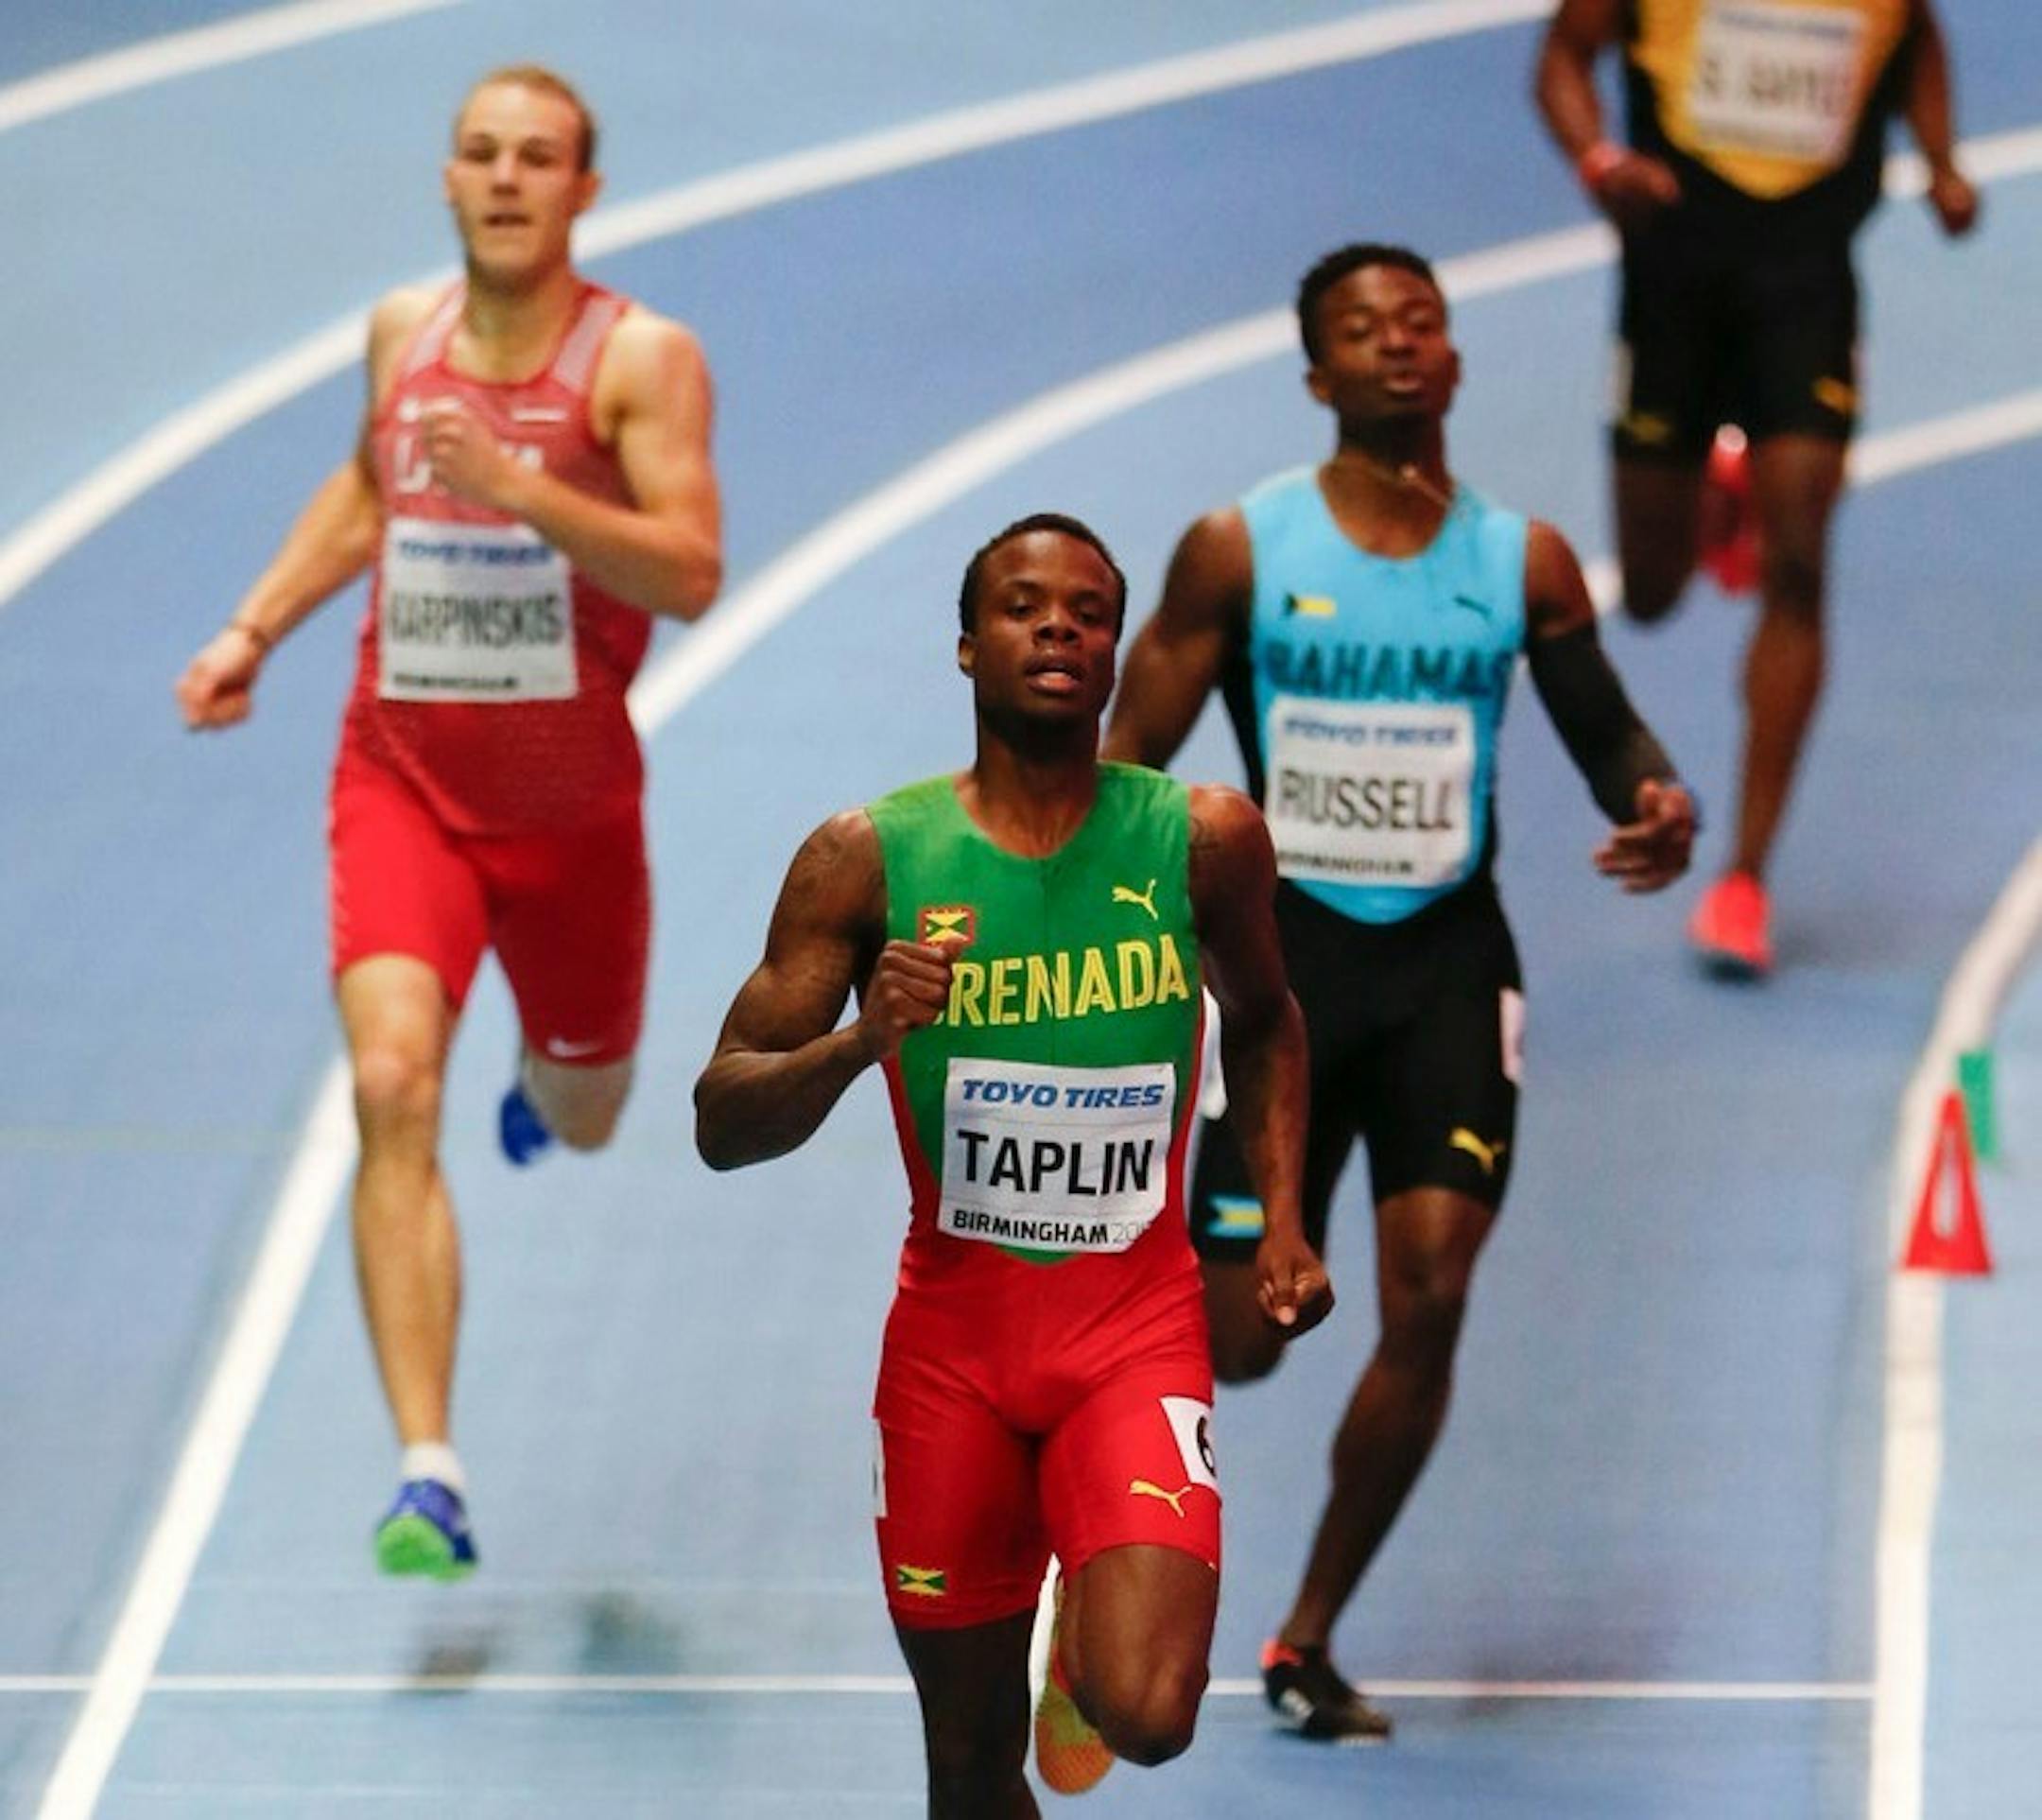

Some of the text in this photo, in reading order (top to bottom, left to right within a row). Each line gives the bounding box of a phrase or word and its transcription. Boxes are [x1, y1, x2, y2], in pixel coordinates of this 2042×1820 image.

[1278, 767, 1454, 832] RUSSELL
[934, 933, 1190, 1027] RENADA
[962, 1079, 1165, 1108] TOYO TIRES
[957, 1130, 1154, 1196] TAPLIN
[953, 1209, 1108, 1244] BIRMINGHAM
